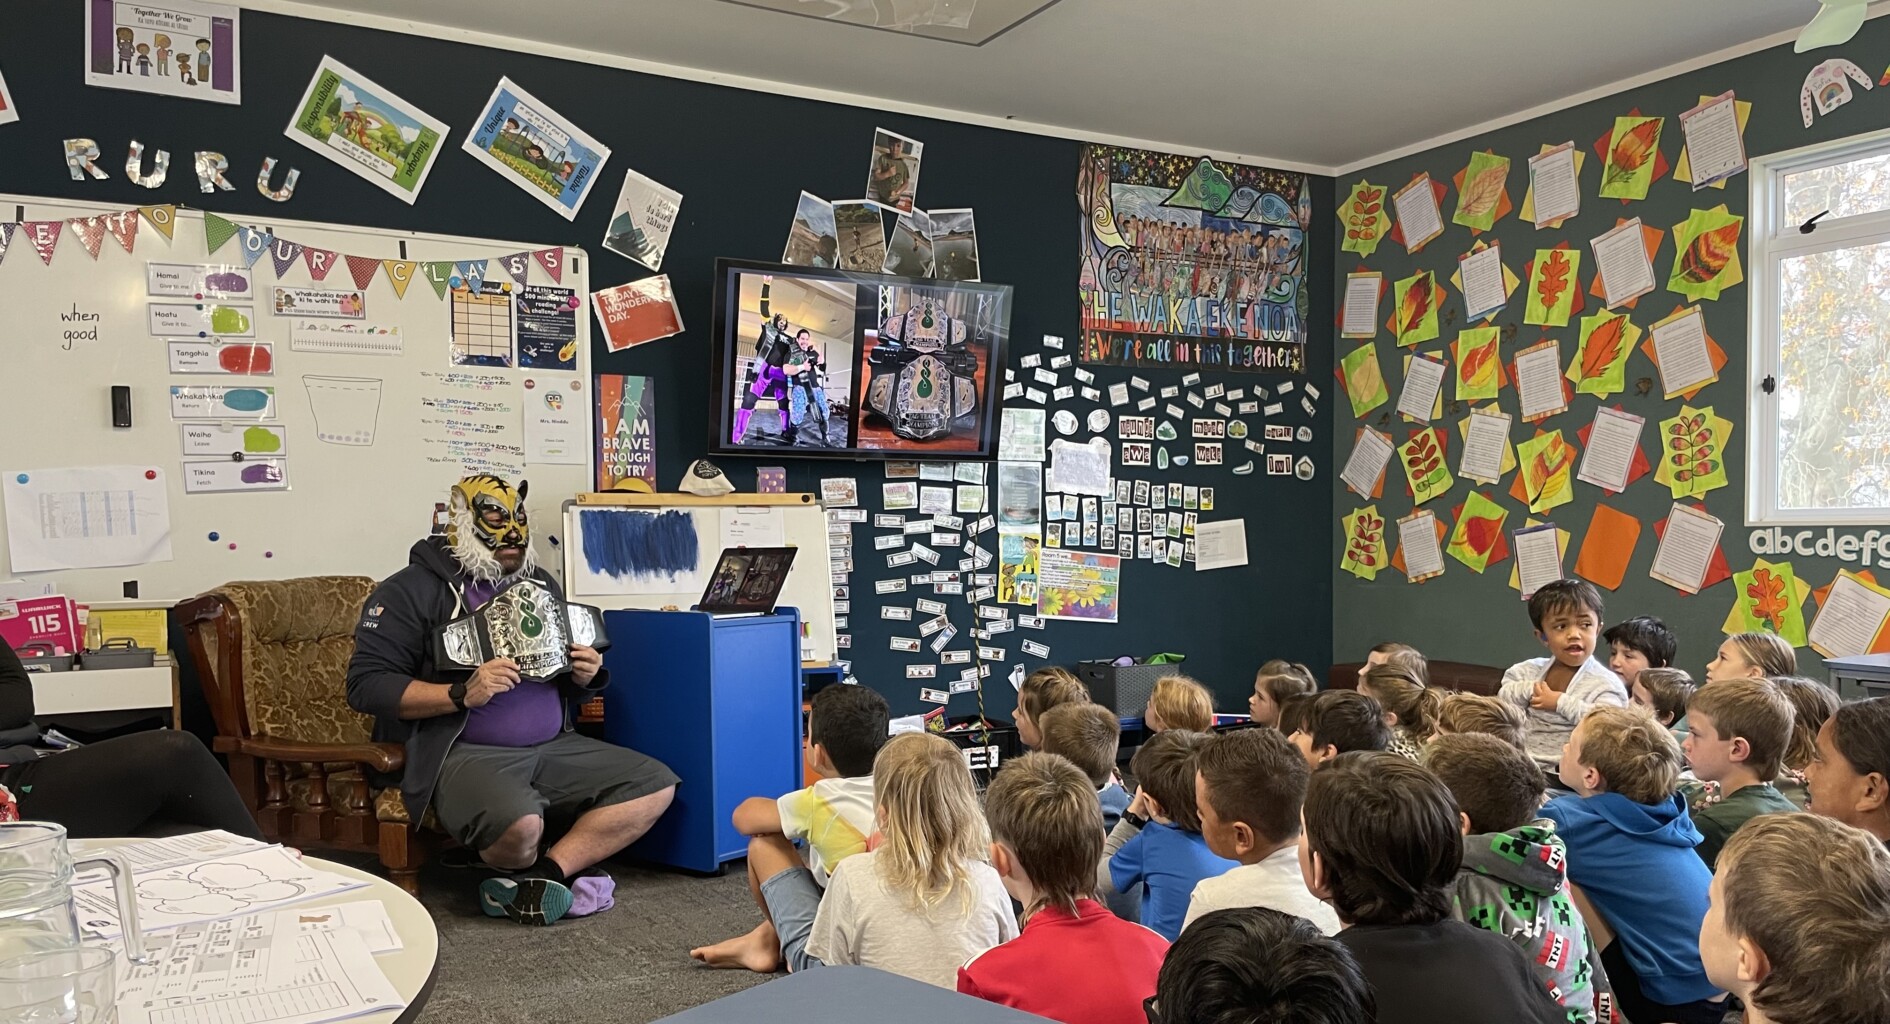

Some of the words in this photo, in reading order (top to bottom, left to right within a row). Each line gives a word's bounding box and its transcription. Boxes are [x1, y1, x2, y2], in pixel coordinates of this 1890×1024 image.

[302, 75, 339, 132] Responsibility
[484, 106, 506, 134] Unique
[646, 215, 669, 233] things
[655, 209, 672, 223] hard
[393, 252, 558, 283] CLASS
[536, 301, 557, 310] reading
[602, 290, 635, 306] TODAY
[61, 302, 100, 322] when
[154, 311, 178, 319] Hoatu
[608, 310, 631, 324] DAY.
[1092, 290, 1123, 330] HE
[1131, 292, 1202, 337] WAKA
[1205, 299, 1248, 339] EKE
[1253, 303, 1300, 342] NOA
[62, 326, 98, 351] good
[176, 350, 209, 359] Tangohia
[1146, 338, 1172, 363] all
[1175, 341, 1190, 363] in
[1194, 341, 1222, 364] this
[1226, 342, 1292, 369] together
[602, 417, 608, 434] I
[615, 418, 650, 436] AM
[905, 420, 939, 428] CHAMPIONS
[188, 431, 212, 439] Waiho
[602, 437, 651, 450] BRAVE
[603, 452, 651, 463] ENOUGH
[193, 469, 216, 477] Tikina
[607, 464, 624, 477] TO
[625, 464, 648, 477] TRY
[27, 613, 62, 635] 115
[362, 621, 379, 629] CREW
[1549, 938, 1563, 964] TNT
[1600, 996, 1611, 1022] TNT
